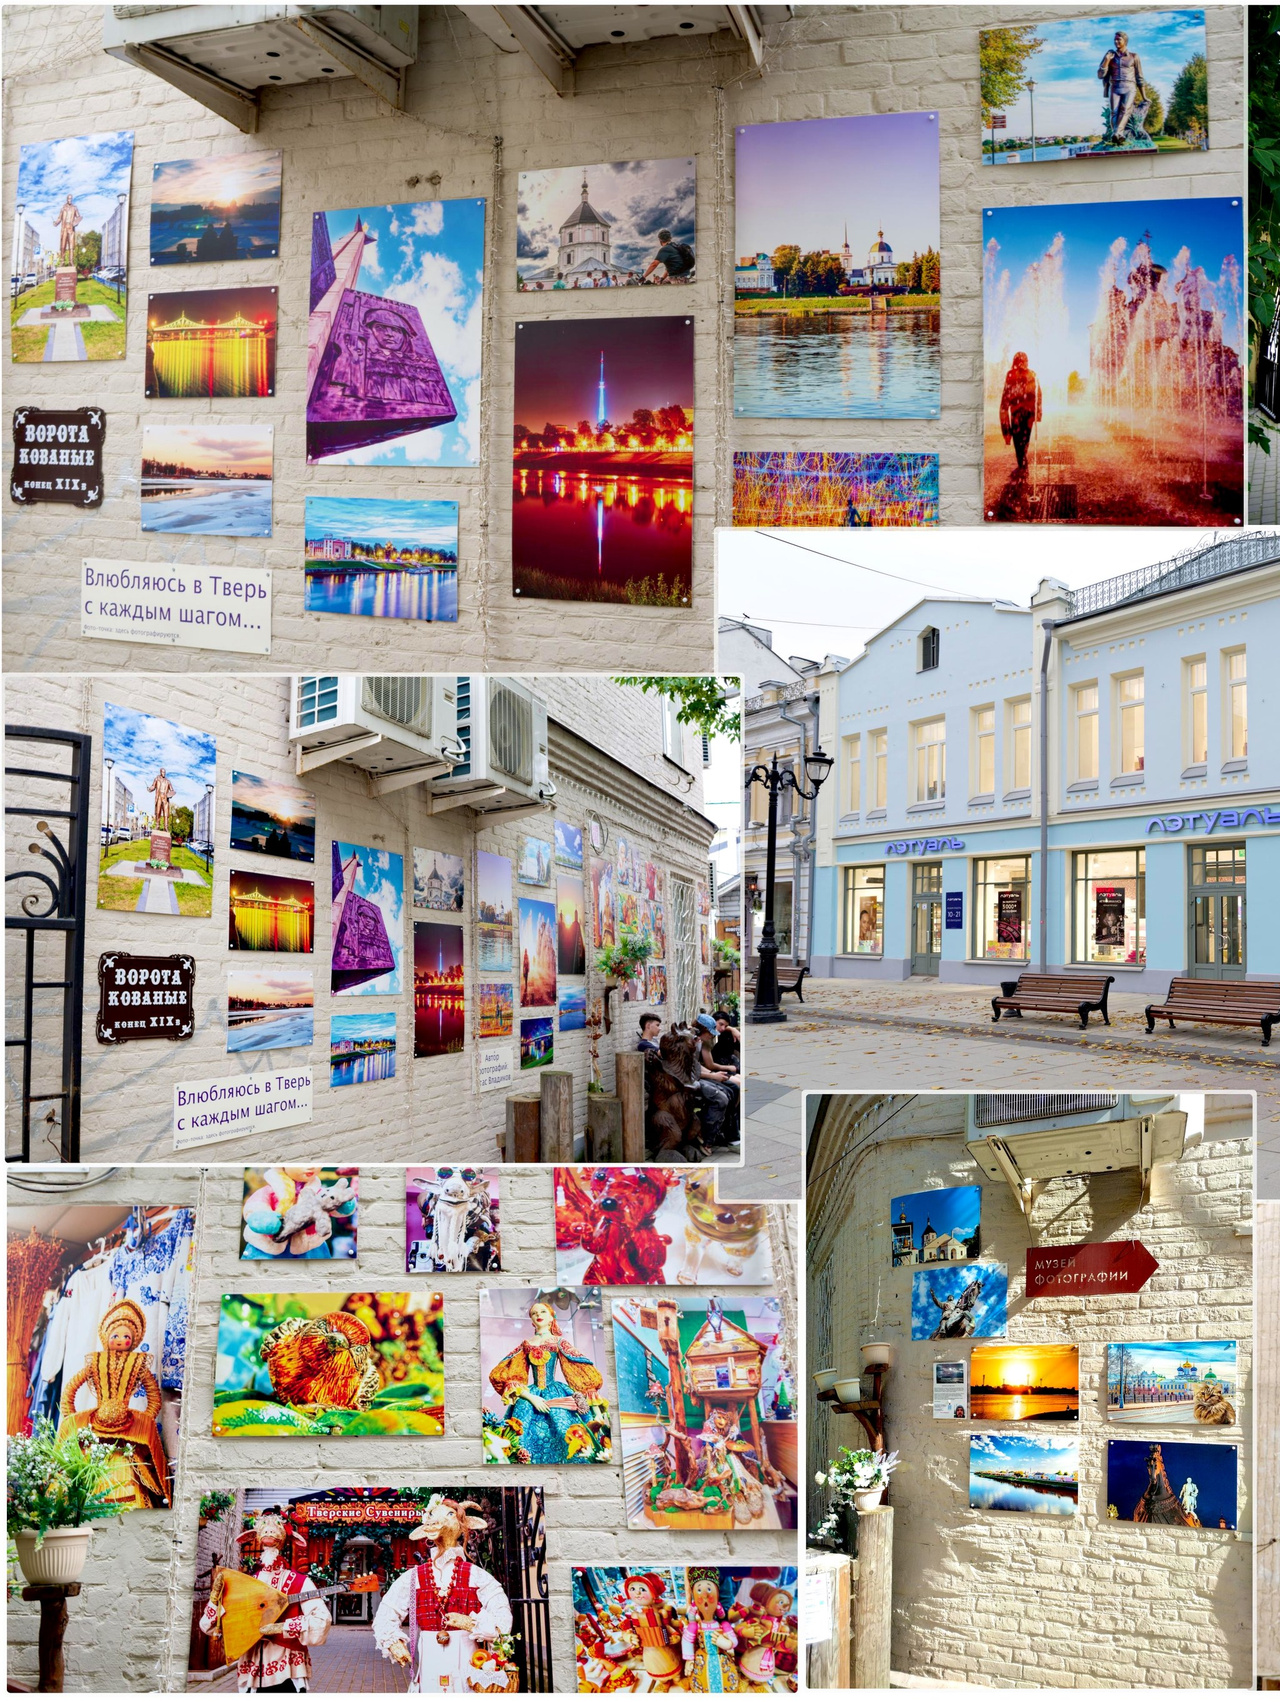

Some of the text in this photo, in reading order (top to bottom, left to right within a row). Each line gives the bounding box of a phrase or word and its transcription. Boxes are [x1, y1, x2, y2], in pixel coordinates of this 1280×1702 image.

[25, 424, 90, 443] ВОРОТА
[19, 448, 94, 466] КОВАНЫЕ
[85, 567, 267, 602] Влюбляюсь в Тверь
[84, 600, 262, 630] с каждым шагом...
[115, 969, 182, 985] ВОРОТА
[108, 991, 187, 1007] КОВАНЫЕ
[485, 1054, 499, 1062] Автор
[178, 1074, 311, 1107] Влюбляюсь в Тверь
[177, 1098, 308, 1131] с каждым шагом...
[1035, 1257, 1076, 1270] МУЗЕЙ
[1035, 1271, 1128, 1286] ФОТОГРАФИИ
[307, 1506, 361, 1519] Тверские
